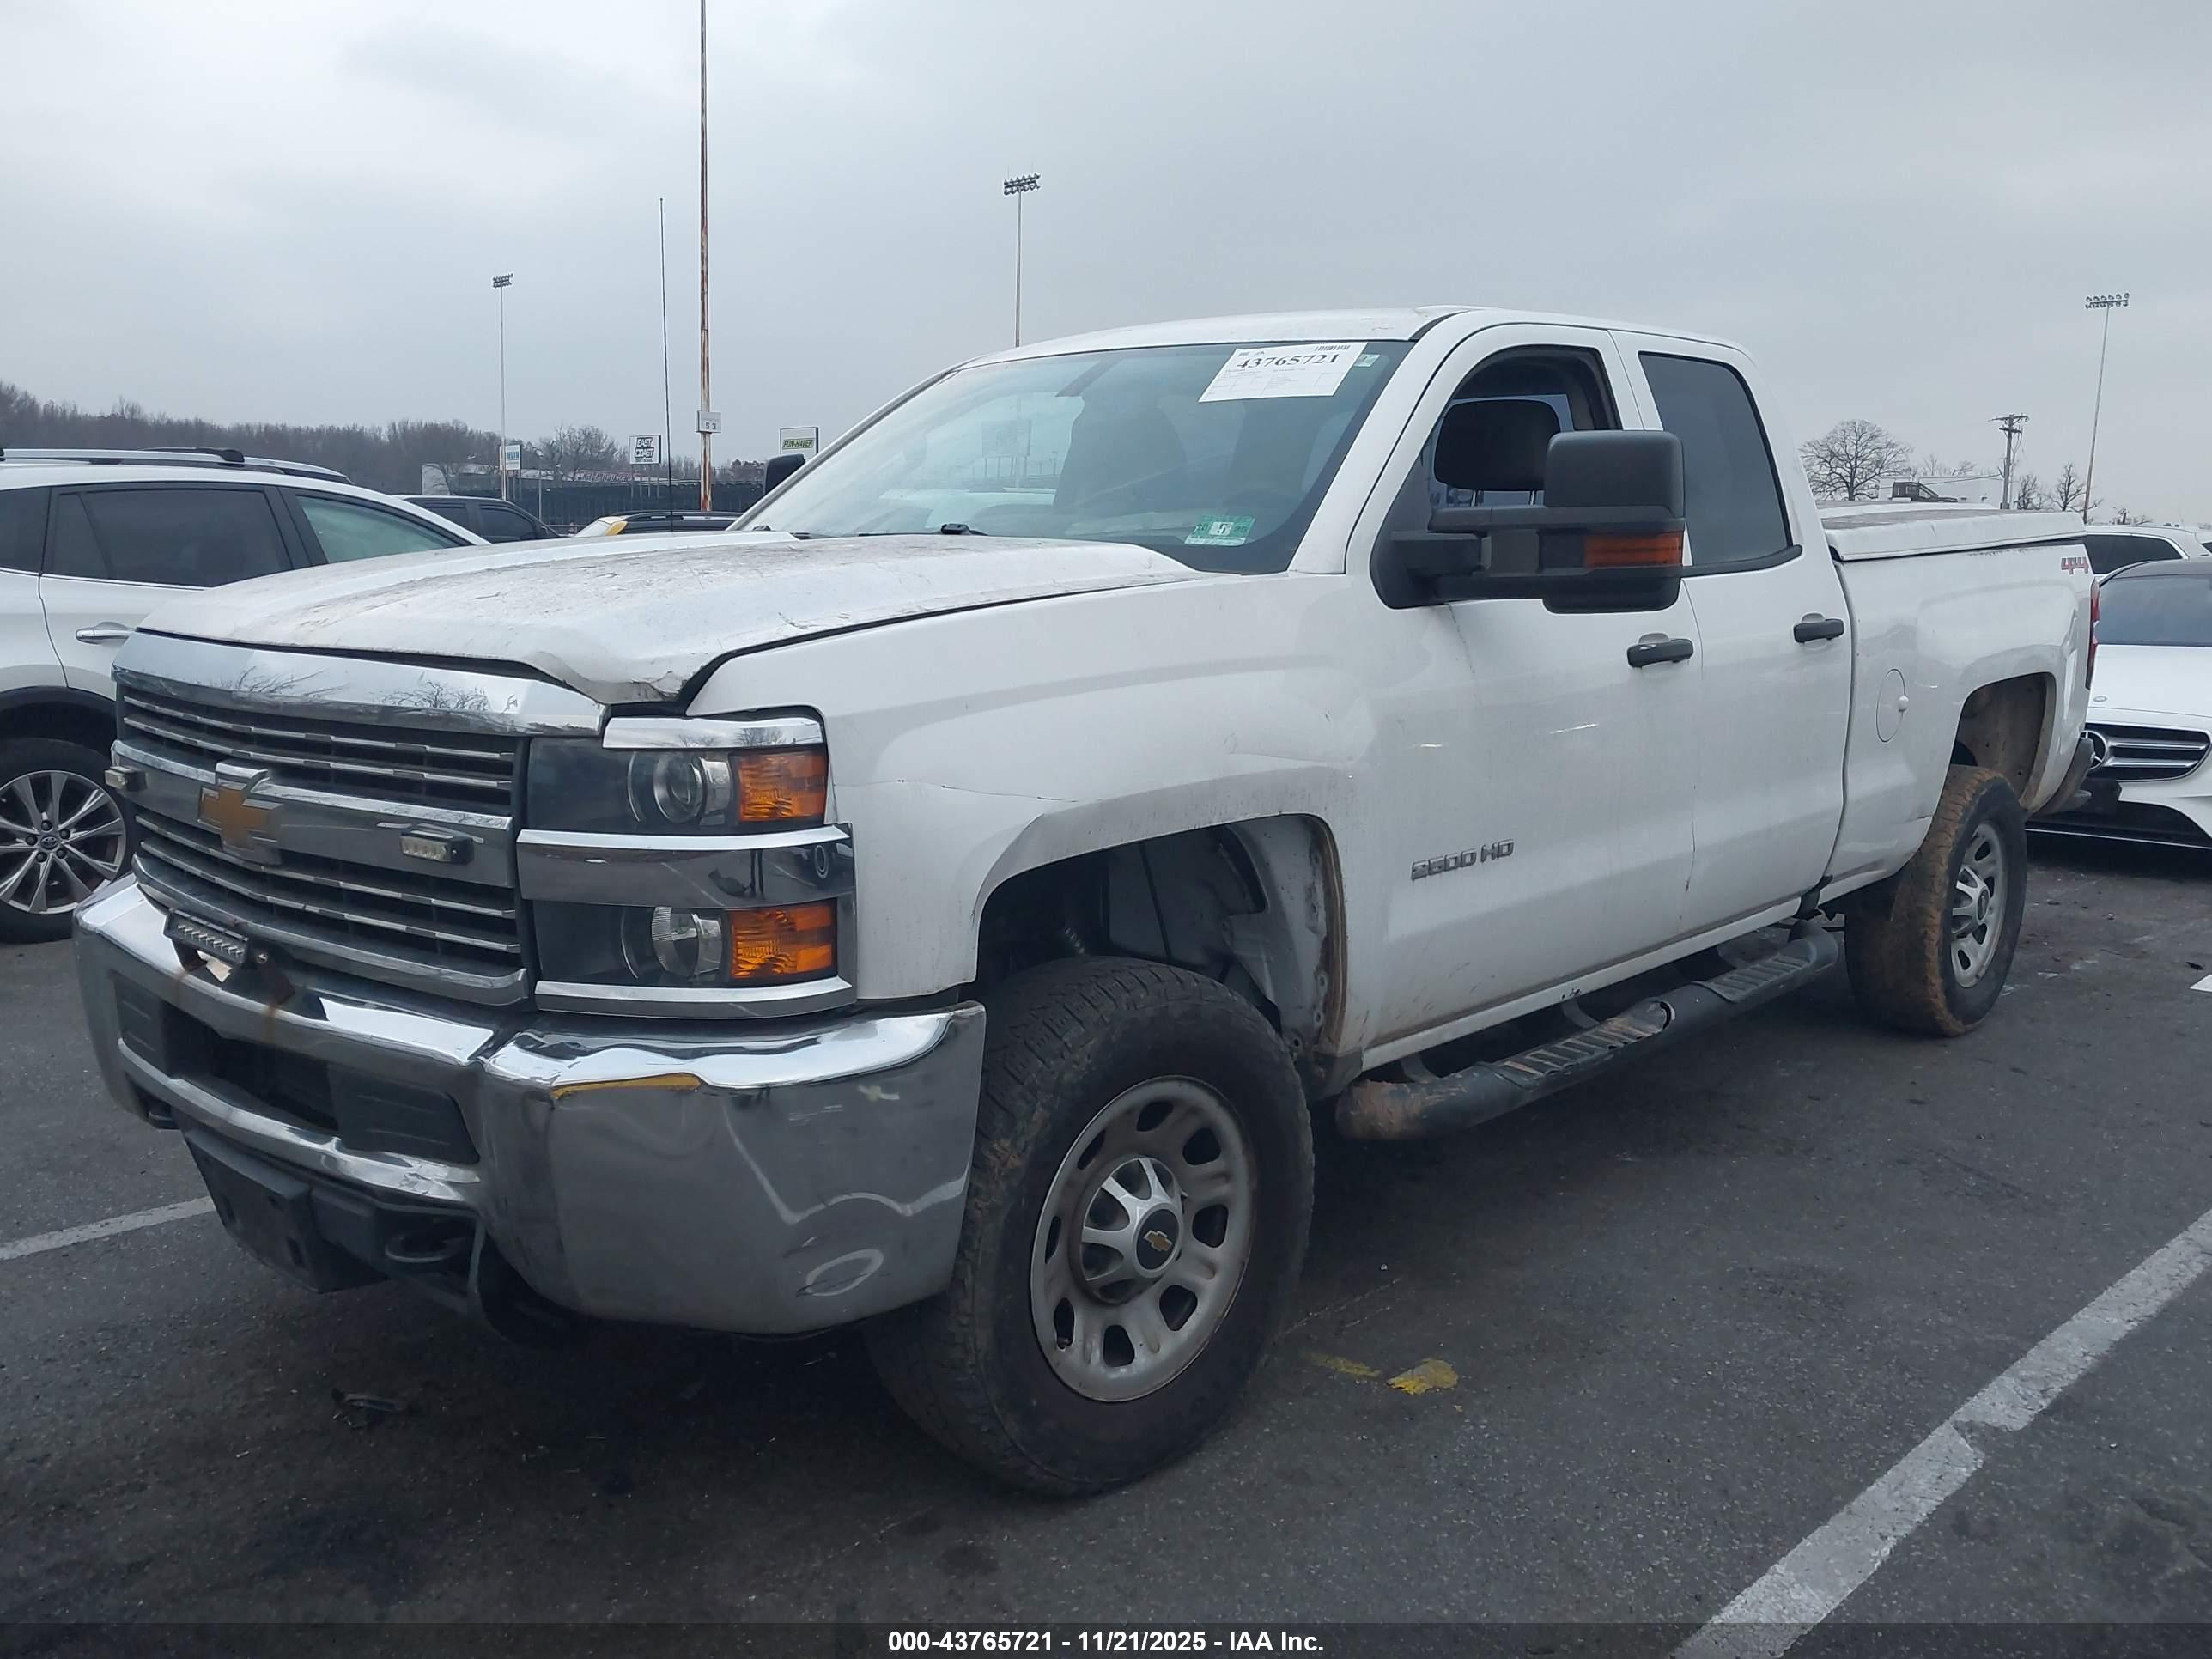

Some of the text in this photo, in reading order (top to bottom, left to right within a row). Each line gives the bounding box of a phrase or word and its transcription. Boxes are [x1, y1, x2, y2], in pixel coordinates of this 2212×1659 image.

[1236, 353, 1340, 368] 43765721
[636, 437, 653, 447] EAST
[635, 447, 654, 458] COAST
[1480, 838, 1514, 863] HD
